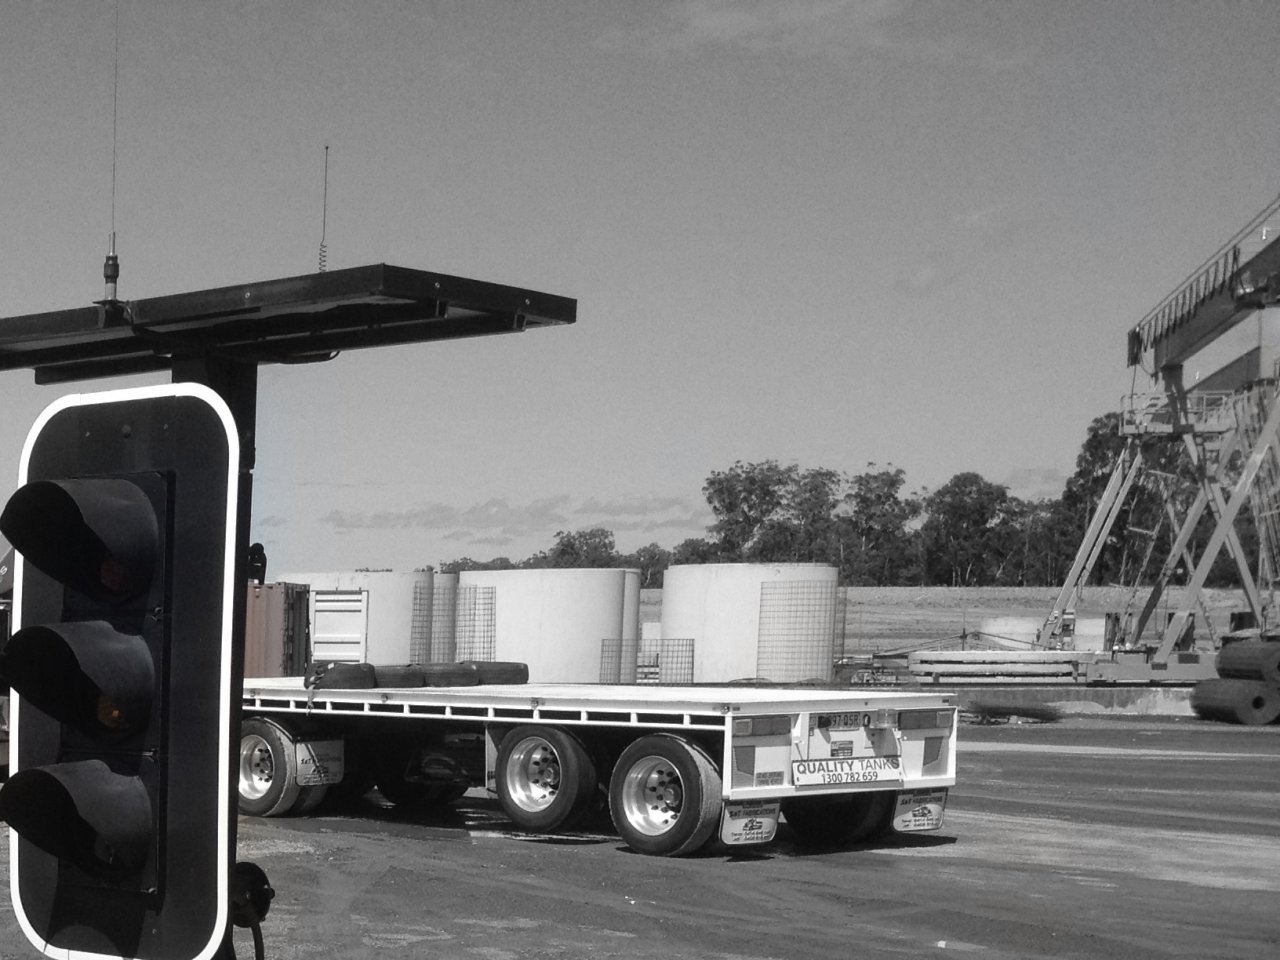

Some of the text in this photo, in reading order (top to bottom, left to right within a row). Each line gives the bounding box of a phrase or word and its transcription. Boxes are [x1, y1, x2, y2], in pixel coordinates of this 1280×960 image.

[796, 757, 900, 775] QUALITY TANKS
[822, 770, 878, 784] 1300 782 659
